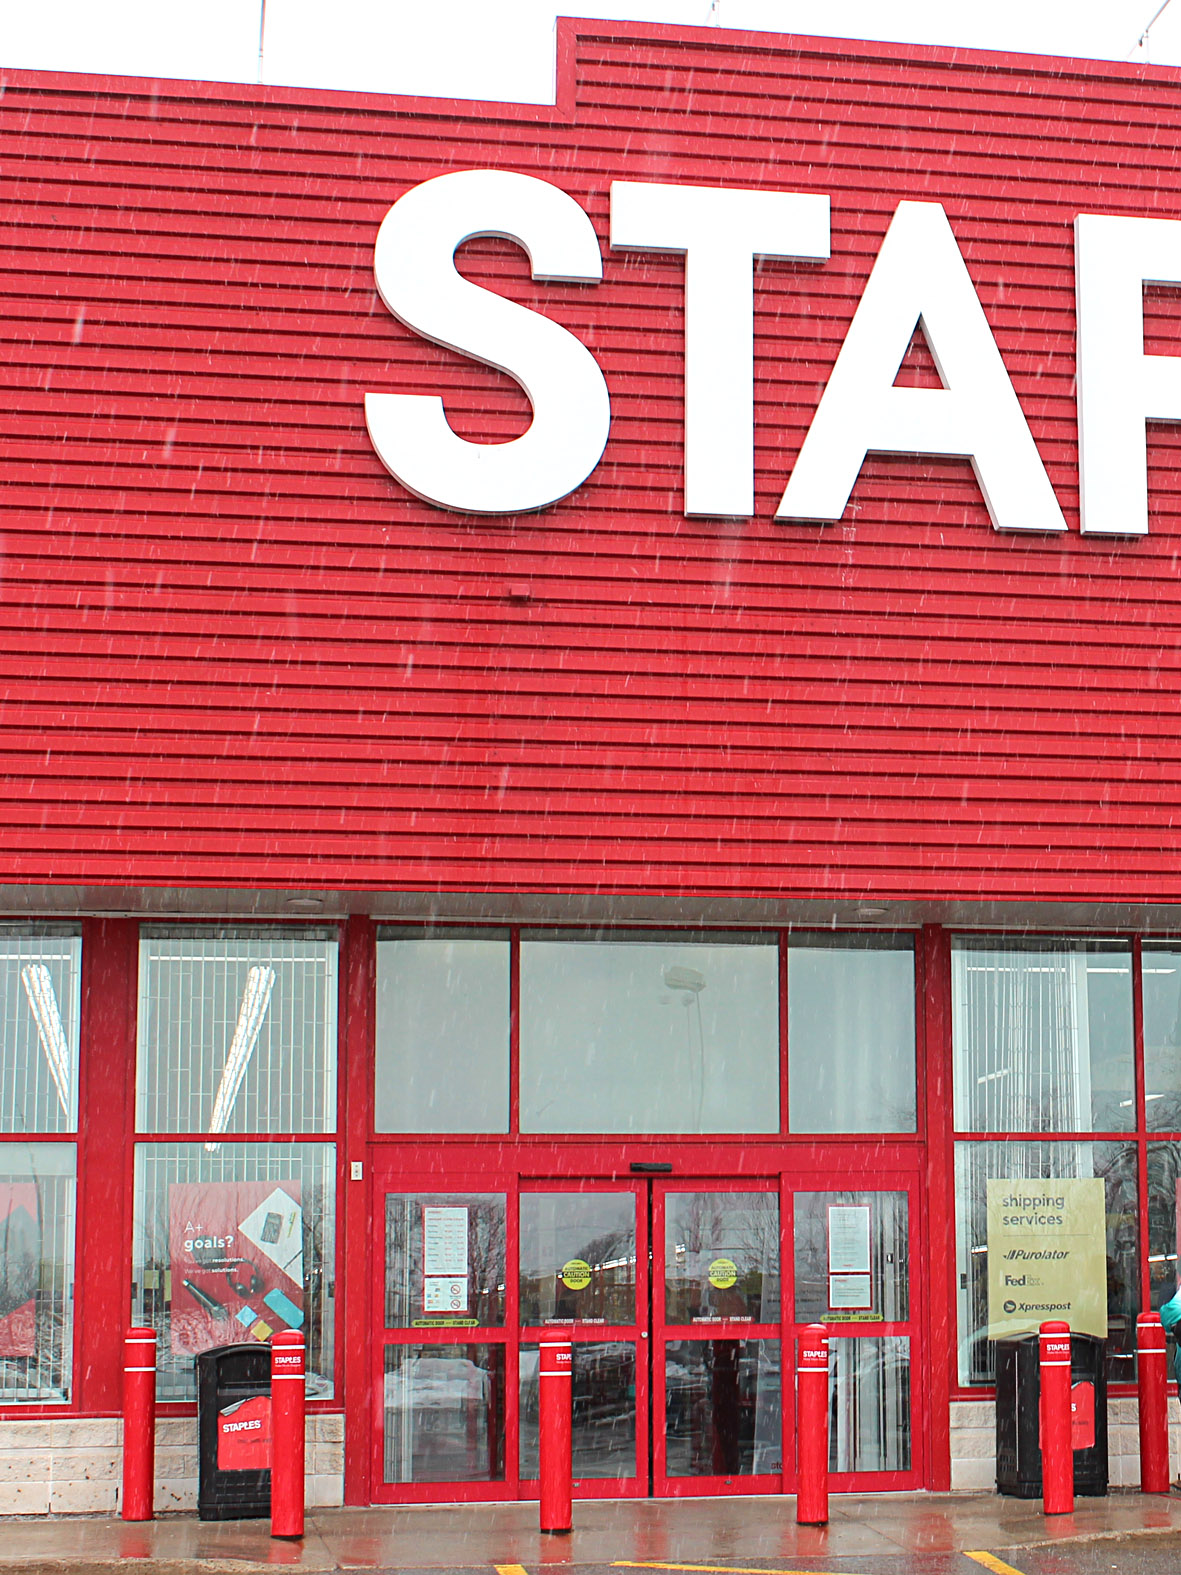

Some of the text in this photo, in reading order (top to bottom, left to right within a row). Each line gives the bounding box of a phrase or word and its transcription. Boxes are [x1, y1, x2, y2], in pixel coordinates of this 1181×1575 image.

[1002, 1194, 1065, 1210] shipping
[1002, 1212, 1063, 1225] services
[183, 1221, 203, 1233] A+
[184, 1235, 234, 1252] goals?
[1014, 1249, 1070, 1260] Purolator
[1018, 1302, 1071, 1313] Xpresspost
[274, 1356, 302, 1364] STAPLES
[803, 1350, 827, 1358] STAPLES
[222, 1419, 262, 1433] STAPLES
